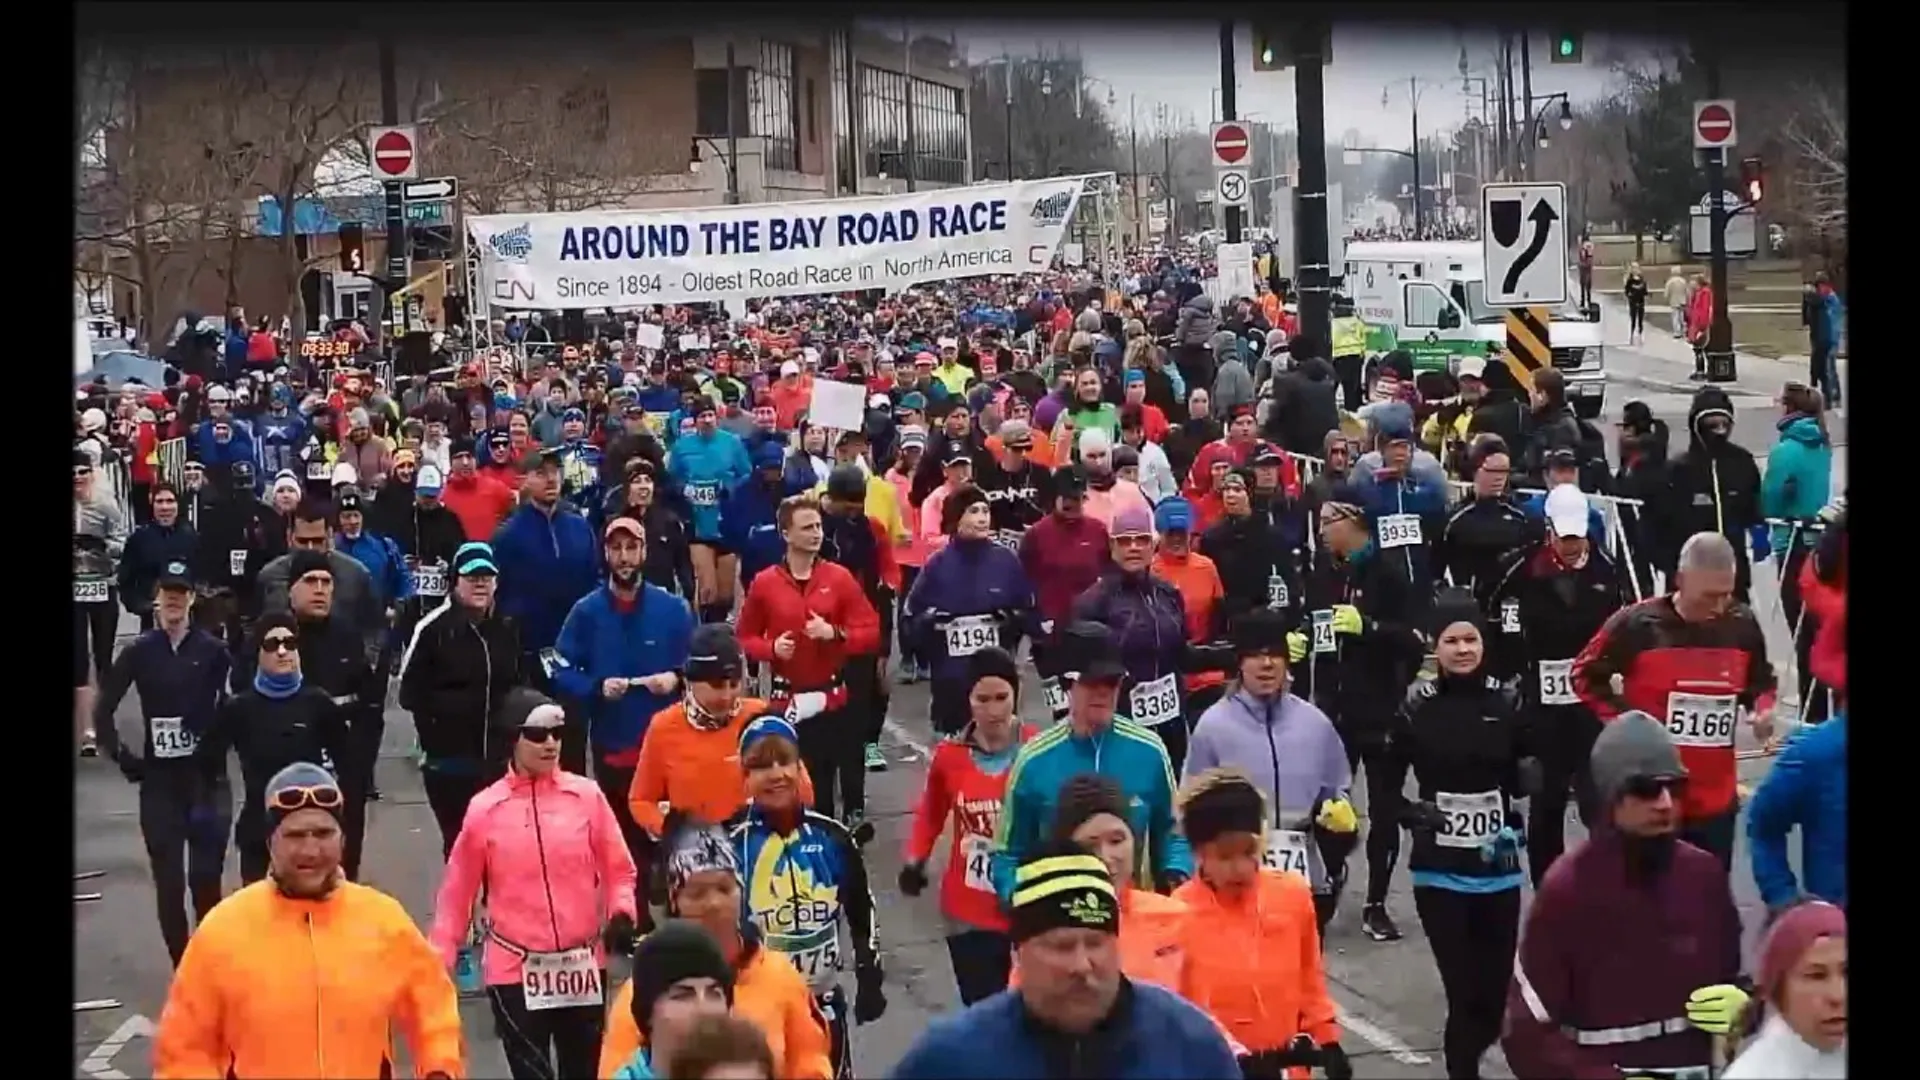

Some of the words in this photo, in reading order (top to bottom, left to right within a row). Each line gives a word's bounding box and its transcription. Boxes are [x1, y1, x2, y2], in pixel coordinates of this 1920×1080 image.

[560, 225, 690, 261] AROUND
[700, 220, 760, 255] THE
[769, 215, 827, 251] BAY
[838, 209, 919, 248] ROAD
[929, 200, 1007, 239] RACE
[556, 277, 609, 298] Since
[617, 274, 662, 295] 1894
[682, 271, 742, 292] Oldest
[750, 267, 799, 289] Road
[805, 264, 852, 285] Race
[859, 263, 873, 281] in
[885, 255, 933, 277] North
[938, 247, 1012, 270] America
[495, 279, 535, 301] CN
[1381, 525, 1418, 542] 3935
[949, 627, 996, 648] 4194
[1134, 688, 1177, 719] 3369
[1668, 710, 1733, 737] 5166
[526, 968, 599, 997] 9160A
